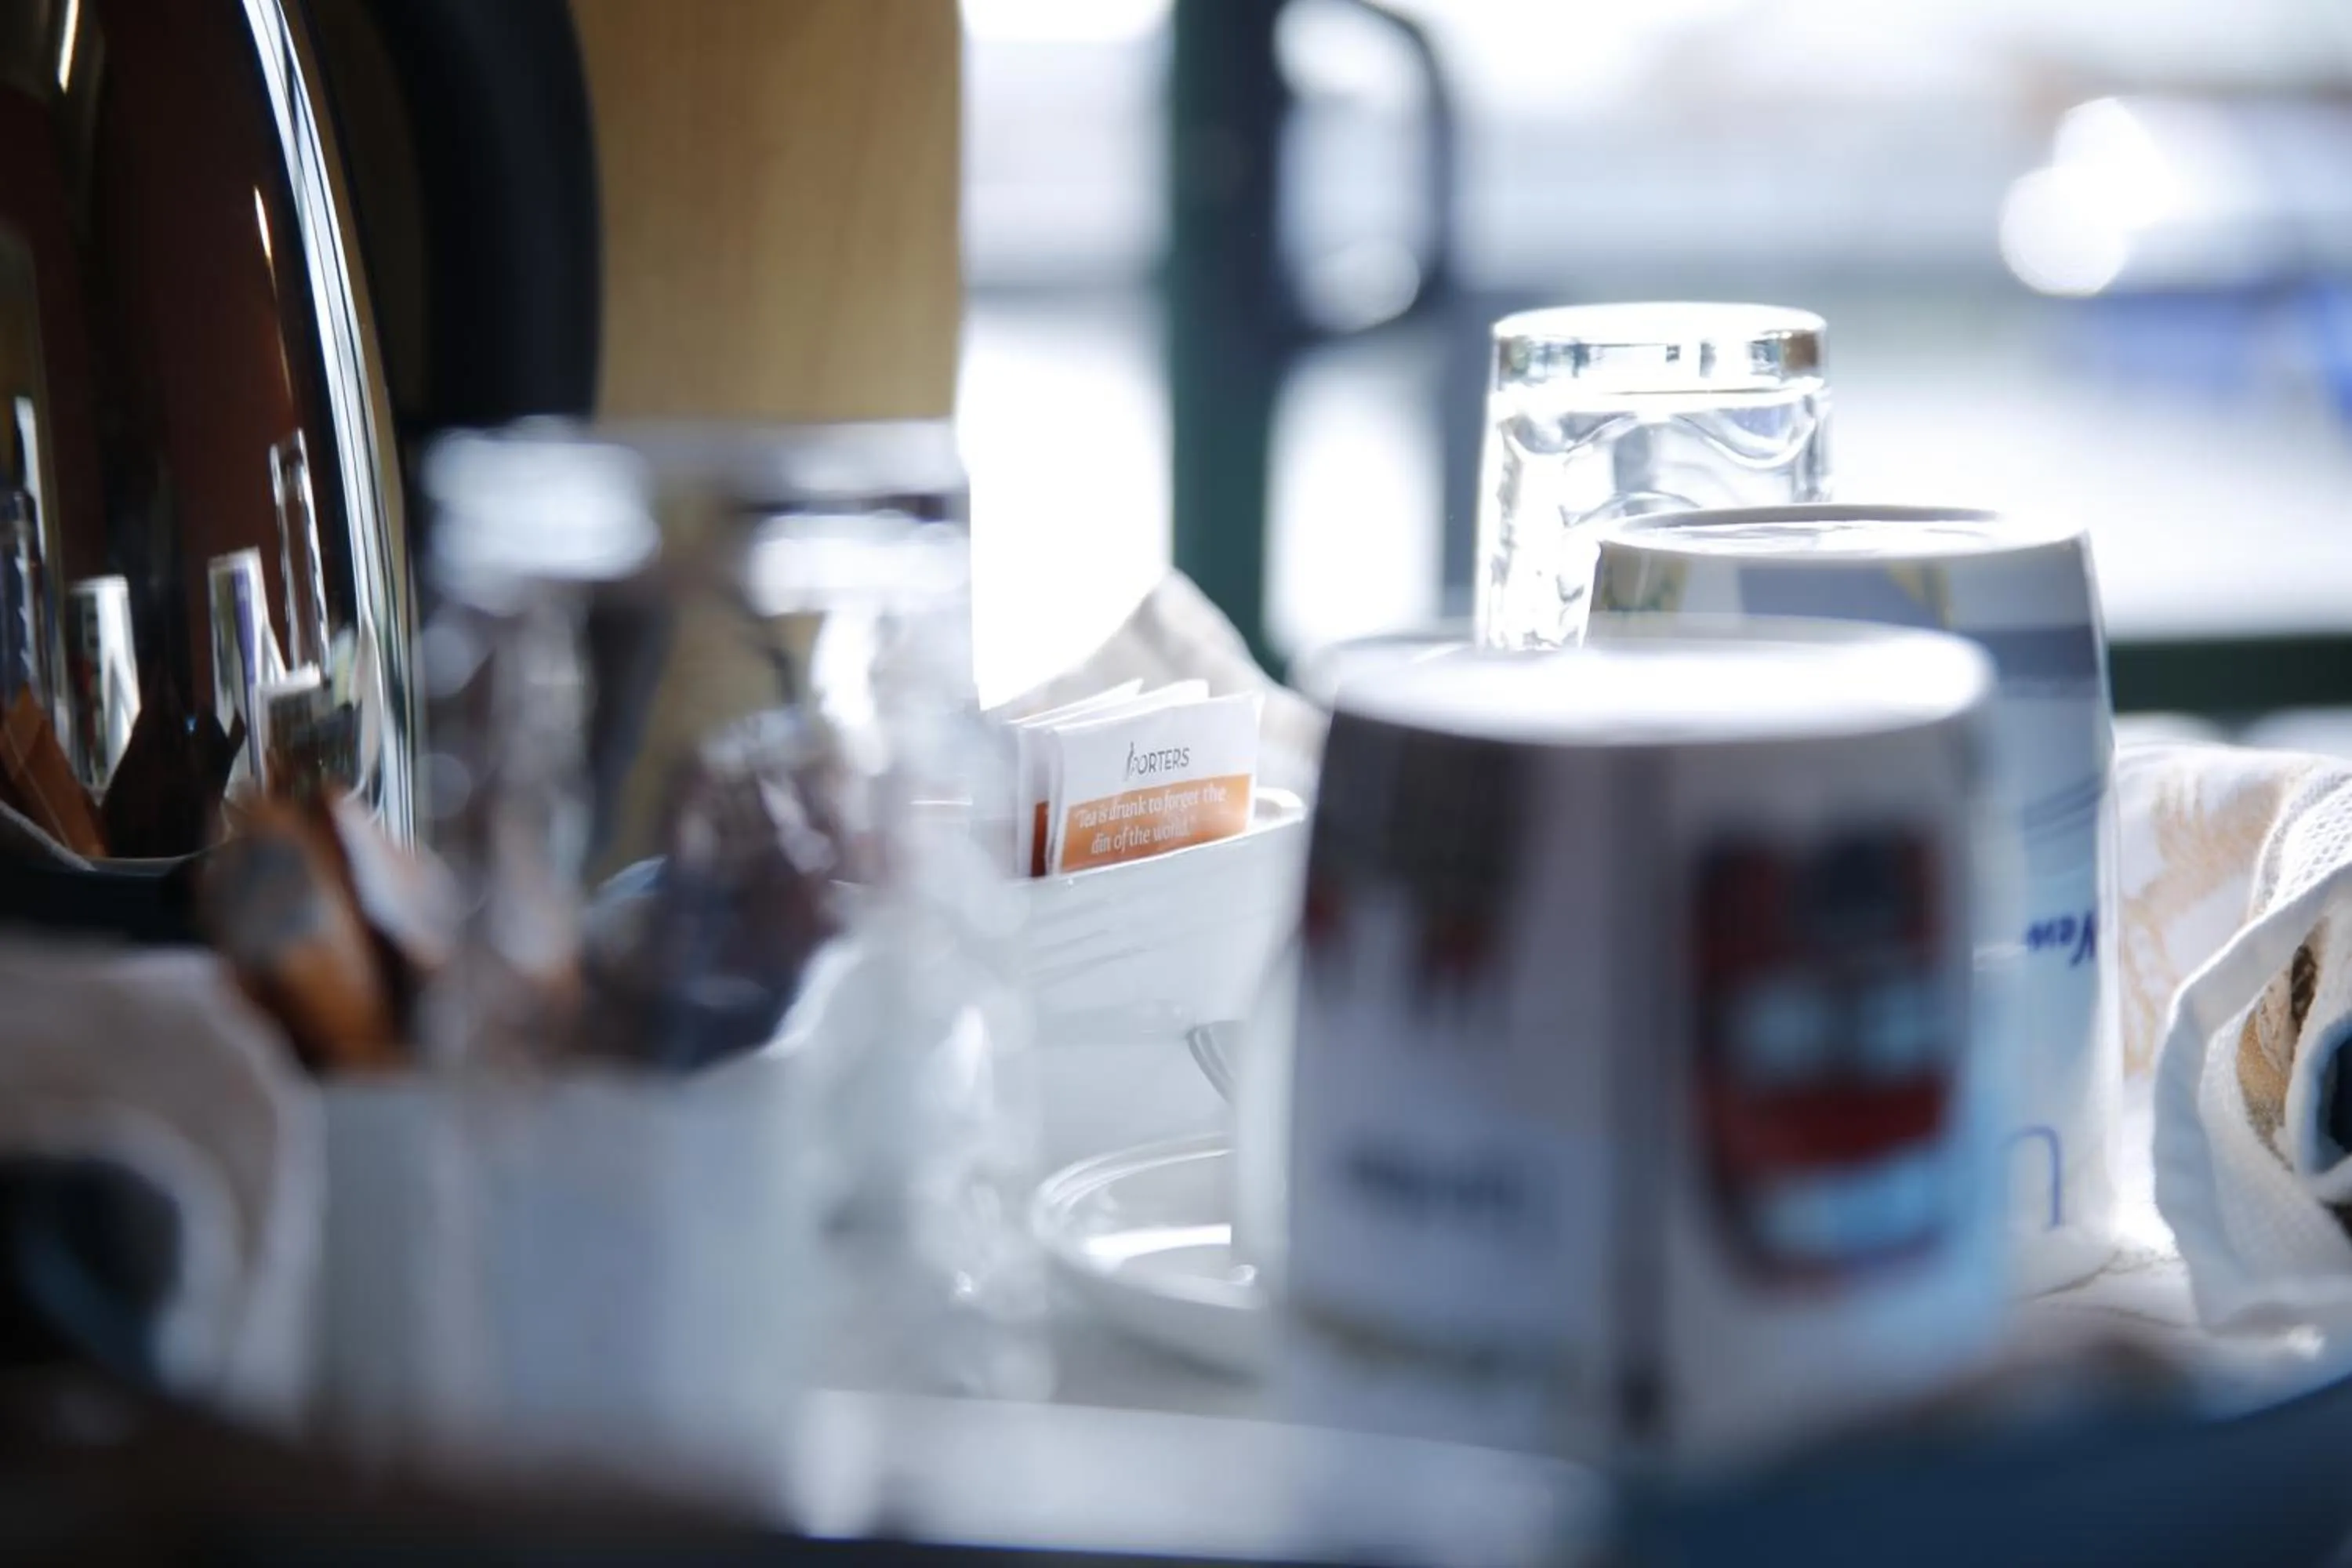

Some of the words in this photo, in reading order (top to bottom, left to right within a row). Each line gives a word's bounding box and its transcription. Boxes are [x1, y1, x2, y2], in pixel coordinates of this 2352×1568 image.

[1124, 741, 1190, 779] PORTERS
[1109, 794, 1148, 821] drunk
[1149, 797, 1162, 814] to
[1163, 789, 1198, 813] forget
[1203, 782, 1226, 803] the
[1091, 831, 1111, 855] din
[1114, 825, 1127, 855] of
[1130, 825, 1150, 847] the
